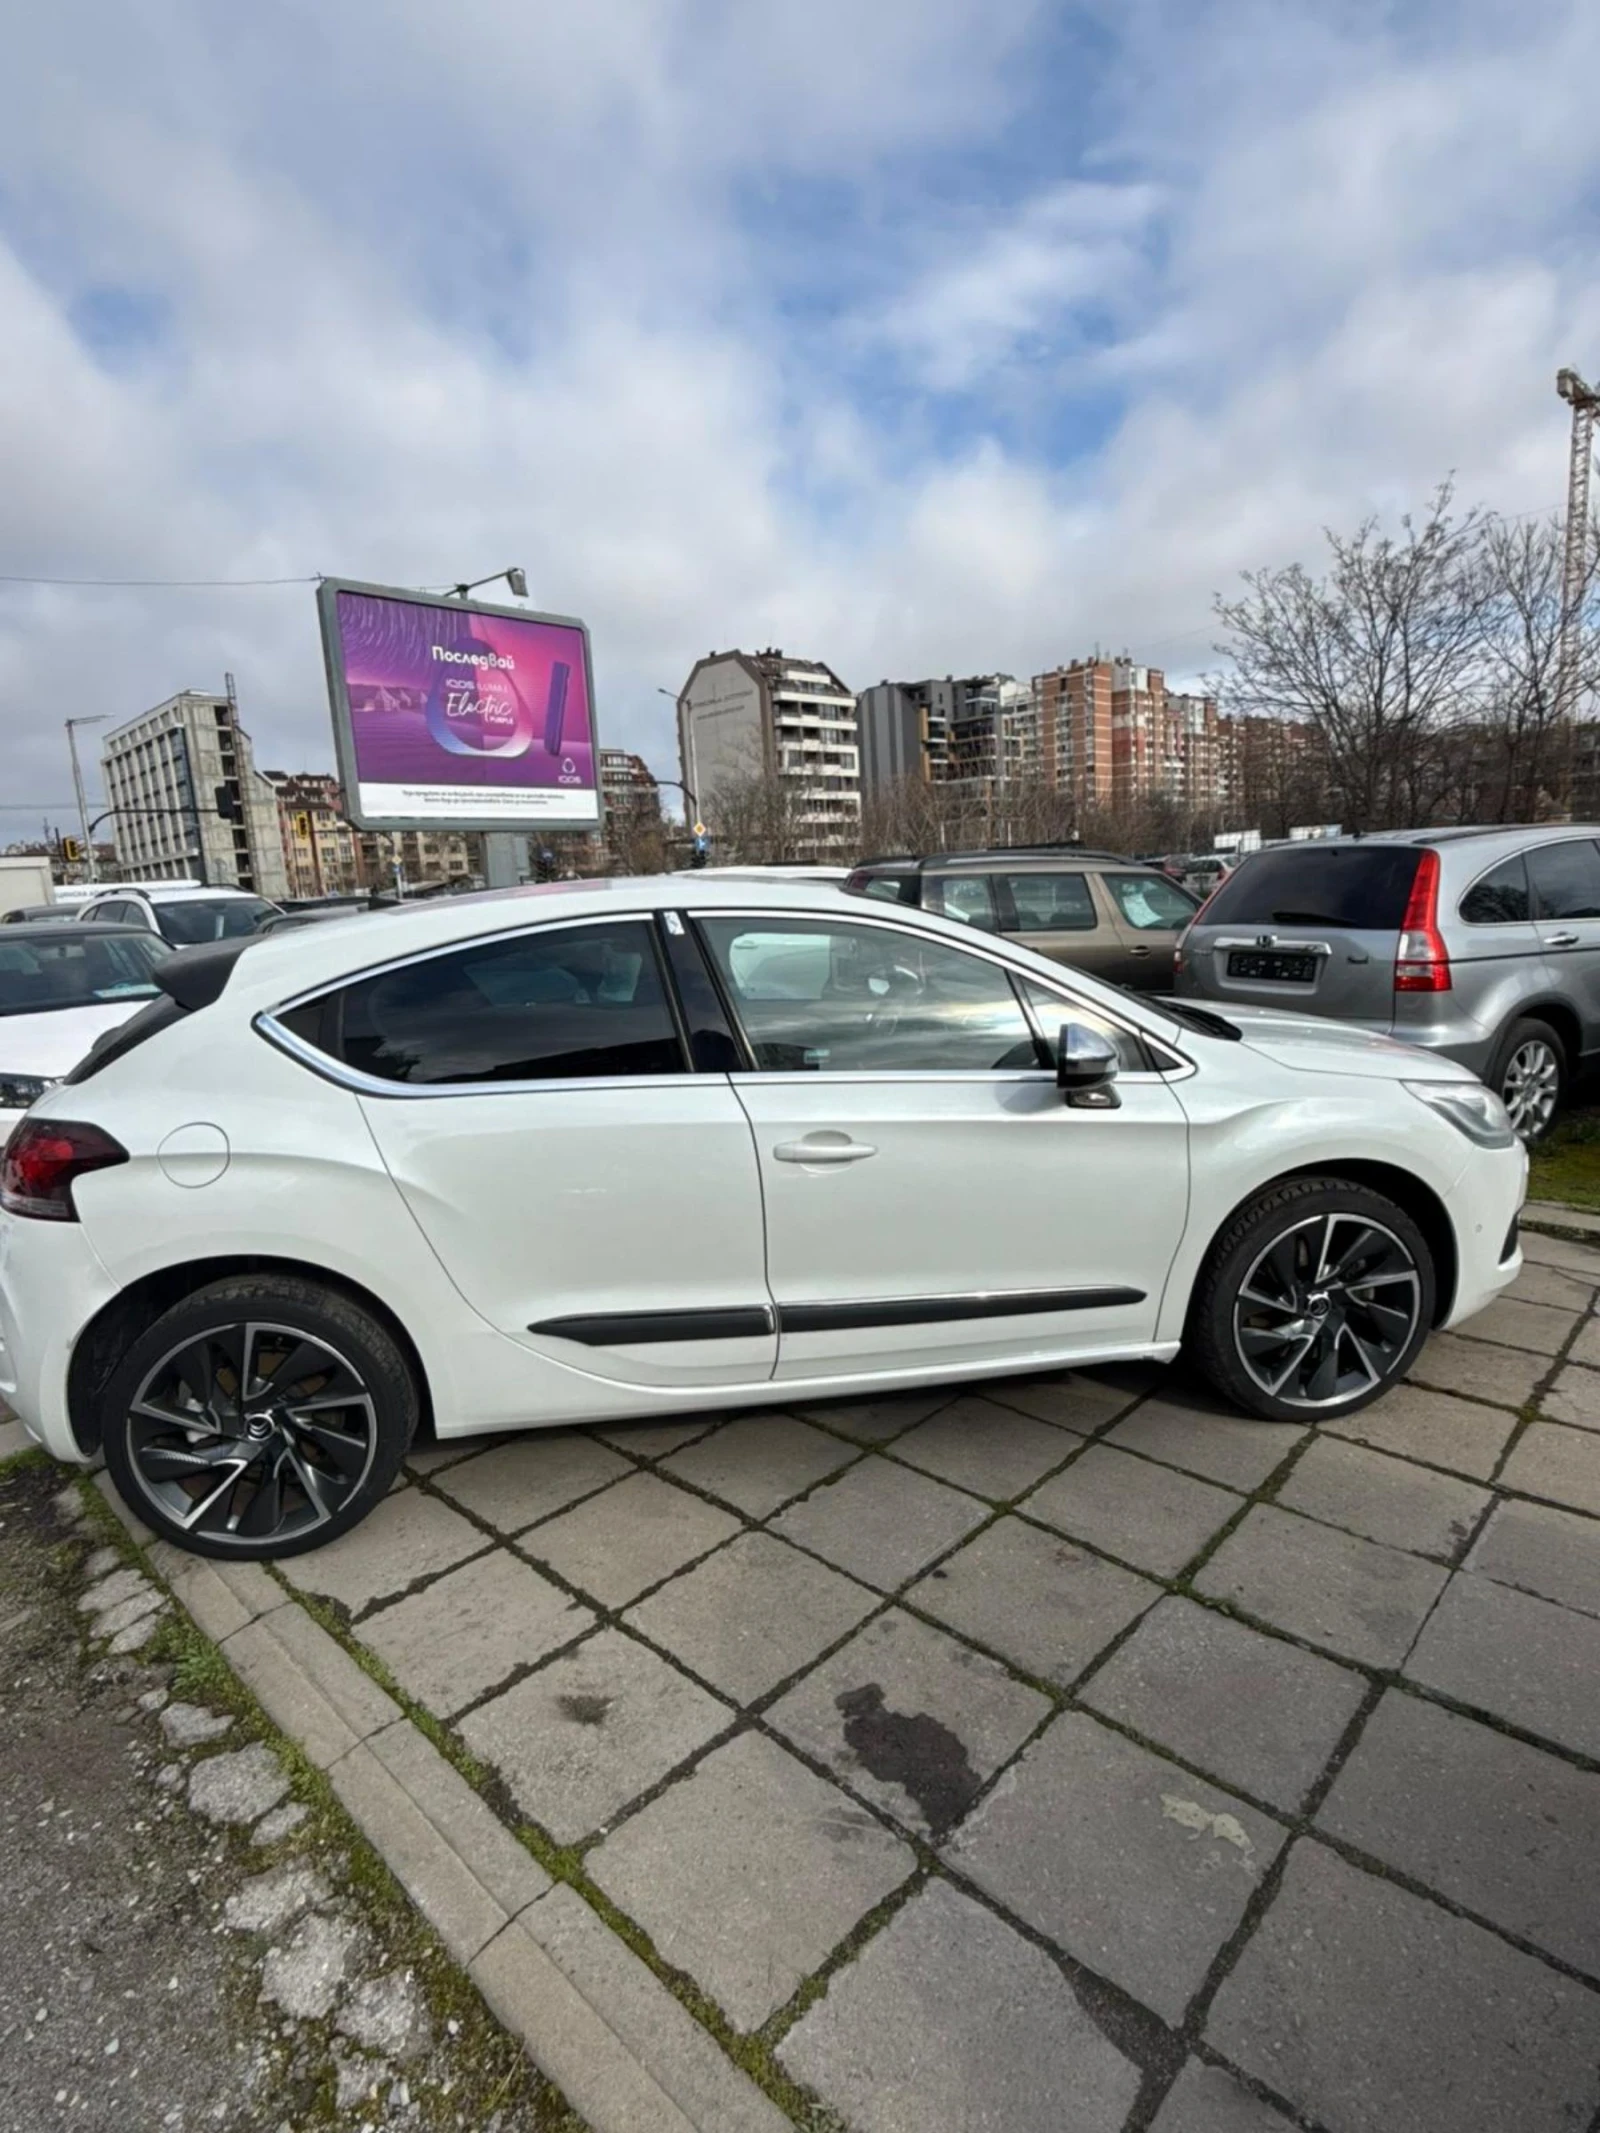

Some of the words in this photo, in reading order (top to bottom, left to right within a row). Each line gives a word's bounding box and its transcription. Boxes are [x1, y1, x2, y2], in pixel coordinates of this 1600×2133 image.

[432, 646, 515, 670] Последвай
[446, 678, 475, 690] IQOS
[446, 691, 512, 722] Electric
[558, 775, 582, 784] IQOS
